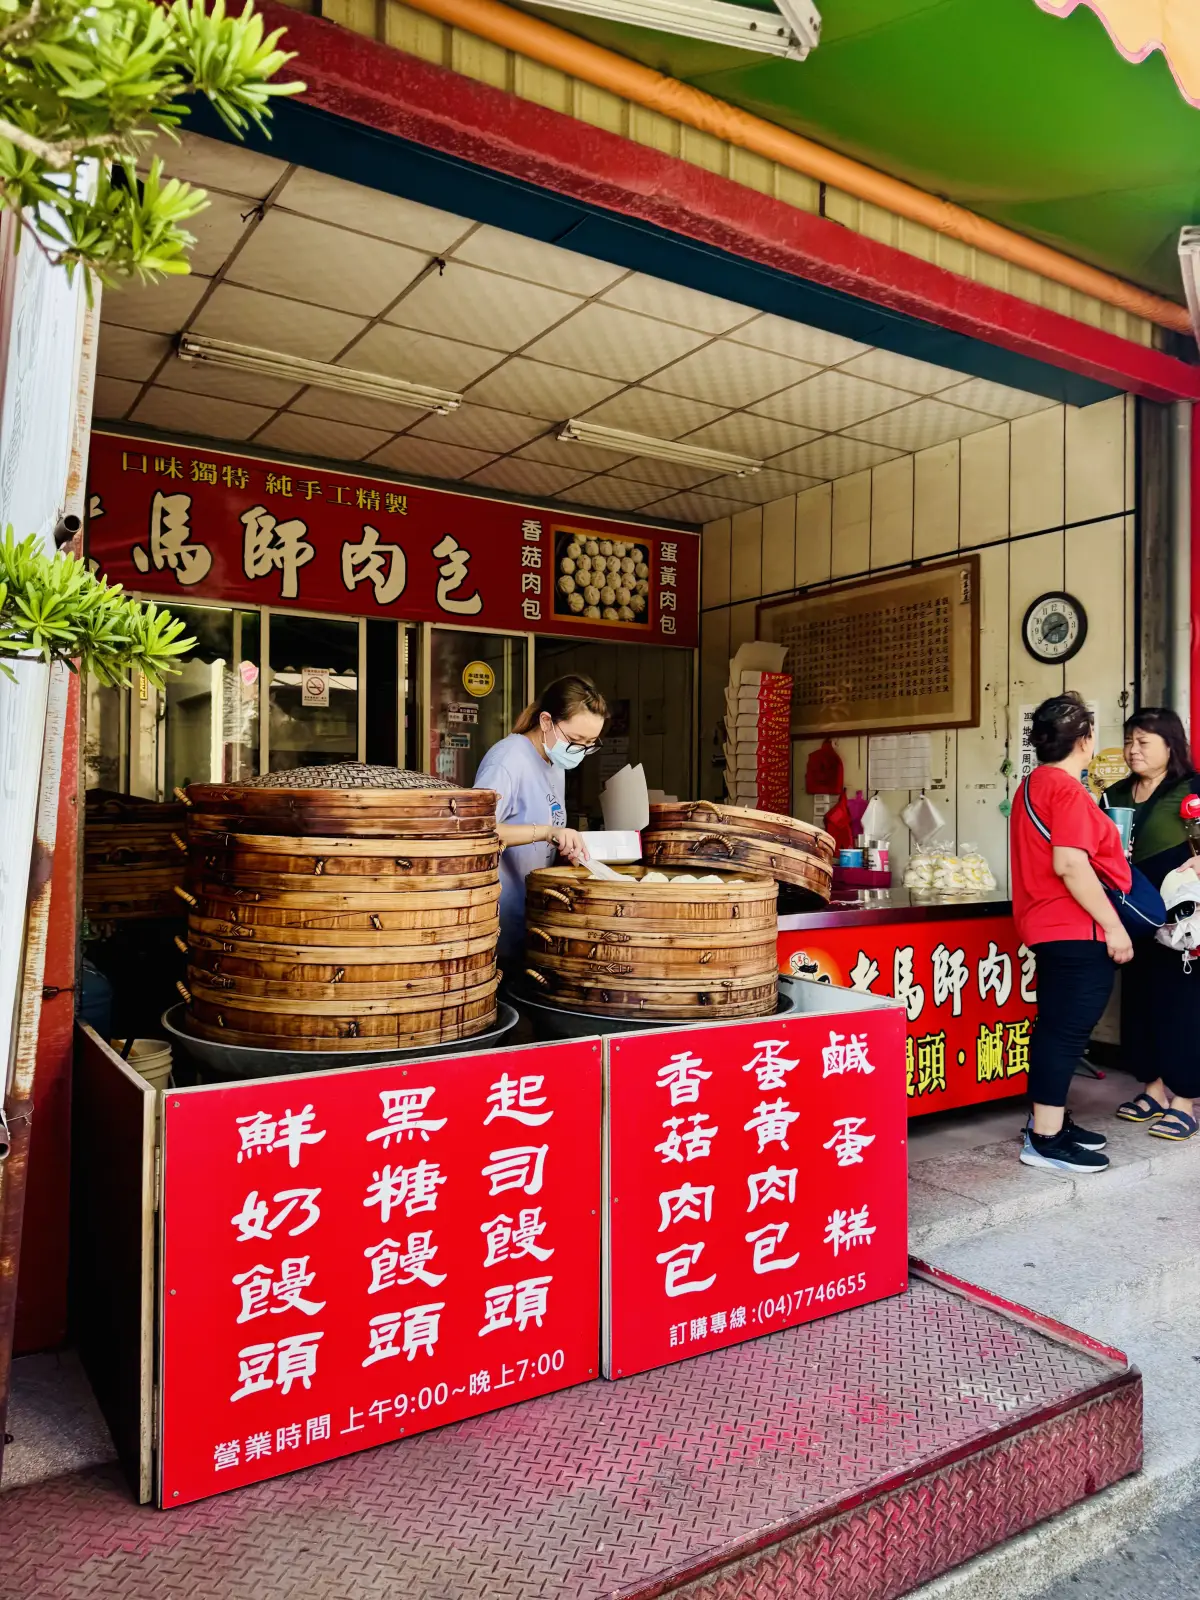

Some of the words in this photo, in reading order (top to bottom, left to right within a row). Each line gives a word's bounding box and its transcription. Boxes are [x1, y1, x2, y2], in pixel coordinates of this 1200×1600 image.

[122, 451, 251, 490] 口味獨特
[265, 472, 409, 516] 純手工精製
[89, 491, 483, 615] 馬師肉包
[521, 519, 542, 620] 香菇肉包
[659, 541, 678, 635] 蛋黃肉包
[1022, 725, 1032, 779] 地球一周の
[479, 1072, 555, 1337] 起司饅頭
[654, 1051, 719, 1297] 香菇肉包
[822, 1030, 877, 1257] 鹹蛋糕
[230, 1103, 326, 1402] 鮮奶饅頭
[362, 1086, 448, 1367] 黑糖饅頭
[213, 1413, 331, 1472] 營業時間
